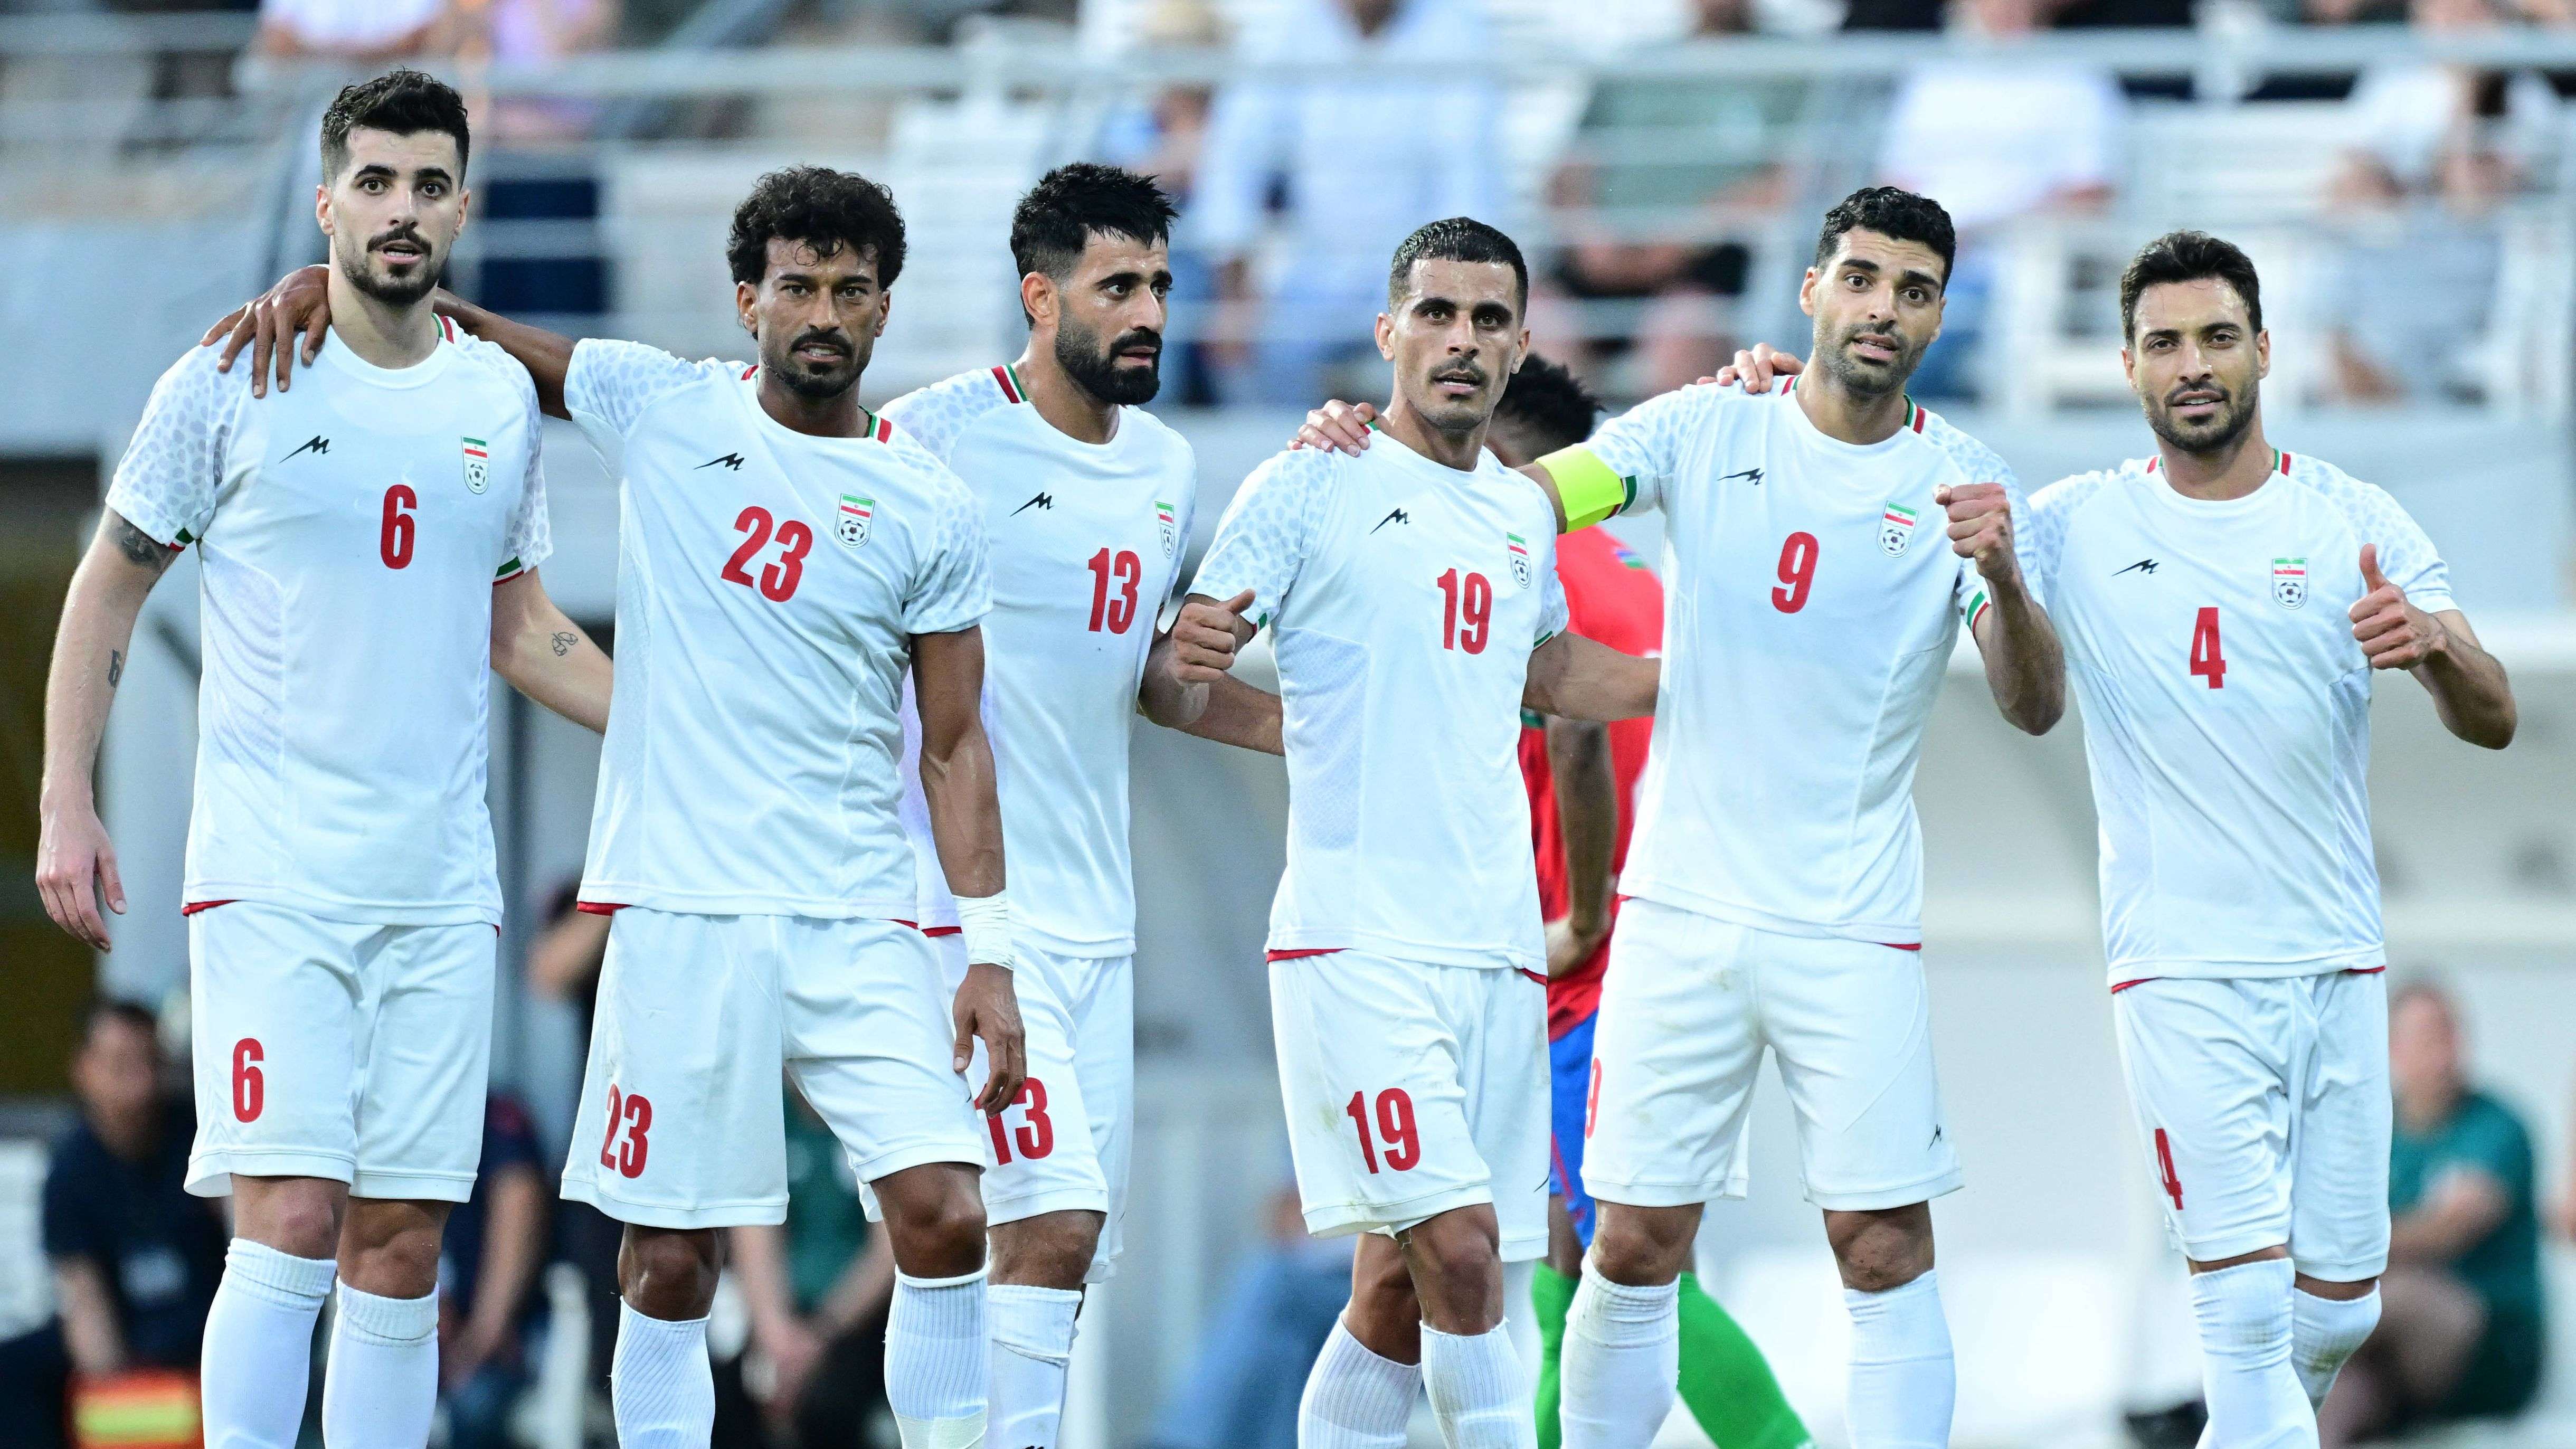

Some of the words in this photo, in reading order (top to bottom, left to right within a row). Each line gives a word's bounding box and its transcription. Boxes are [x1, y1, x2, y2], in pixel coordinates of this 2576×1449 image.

[381, 485, 416, 569] 6
[721, 506, 812, 602] 23
[1088, 548, 1141, 634] 13
[1437, 568, 1492, 654] 19
[1772, 532, 1819, 613] 9
[2190, 607, 2226, 689] 4
[232, 1038, 264, 1122] 6
[974, 1077, 1054, 1166] 13
[1585, 1057, 1603, 1139] 9
[600, 1083, 652, 1178] 23
[1347, 1087, 1420, 1174] 19
[2155, 1129, 2183, 1210] 4
